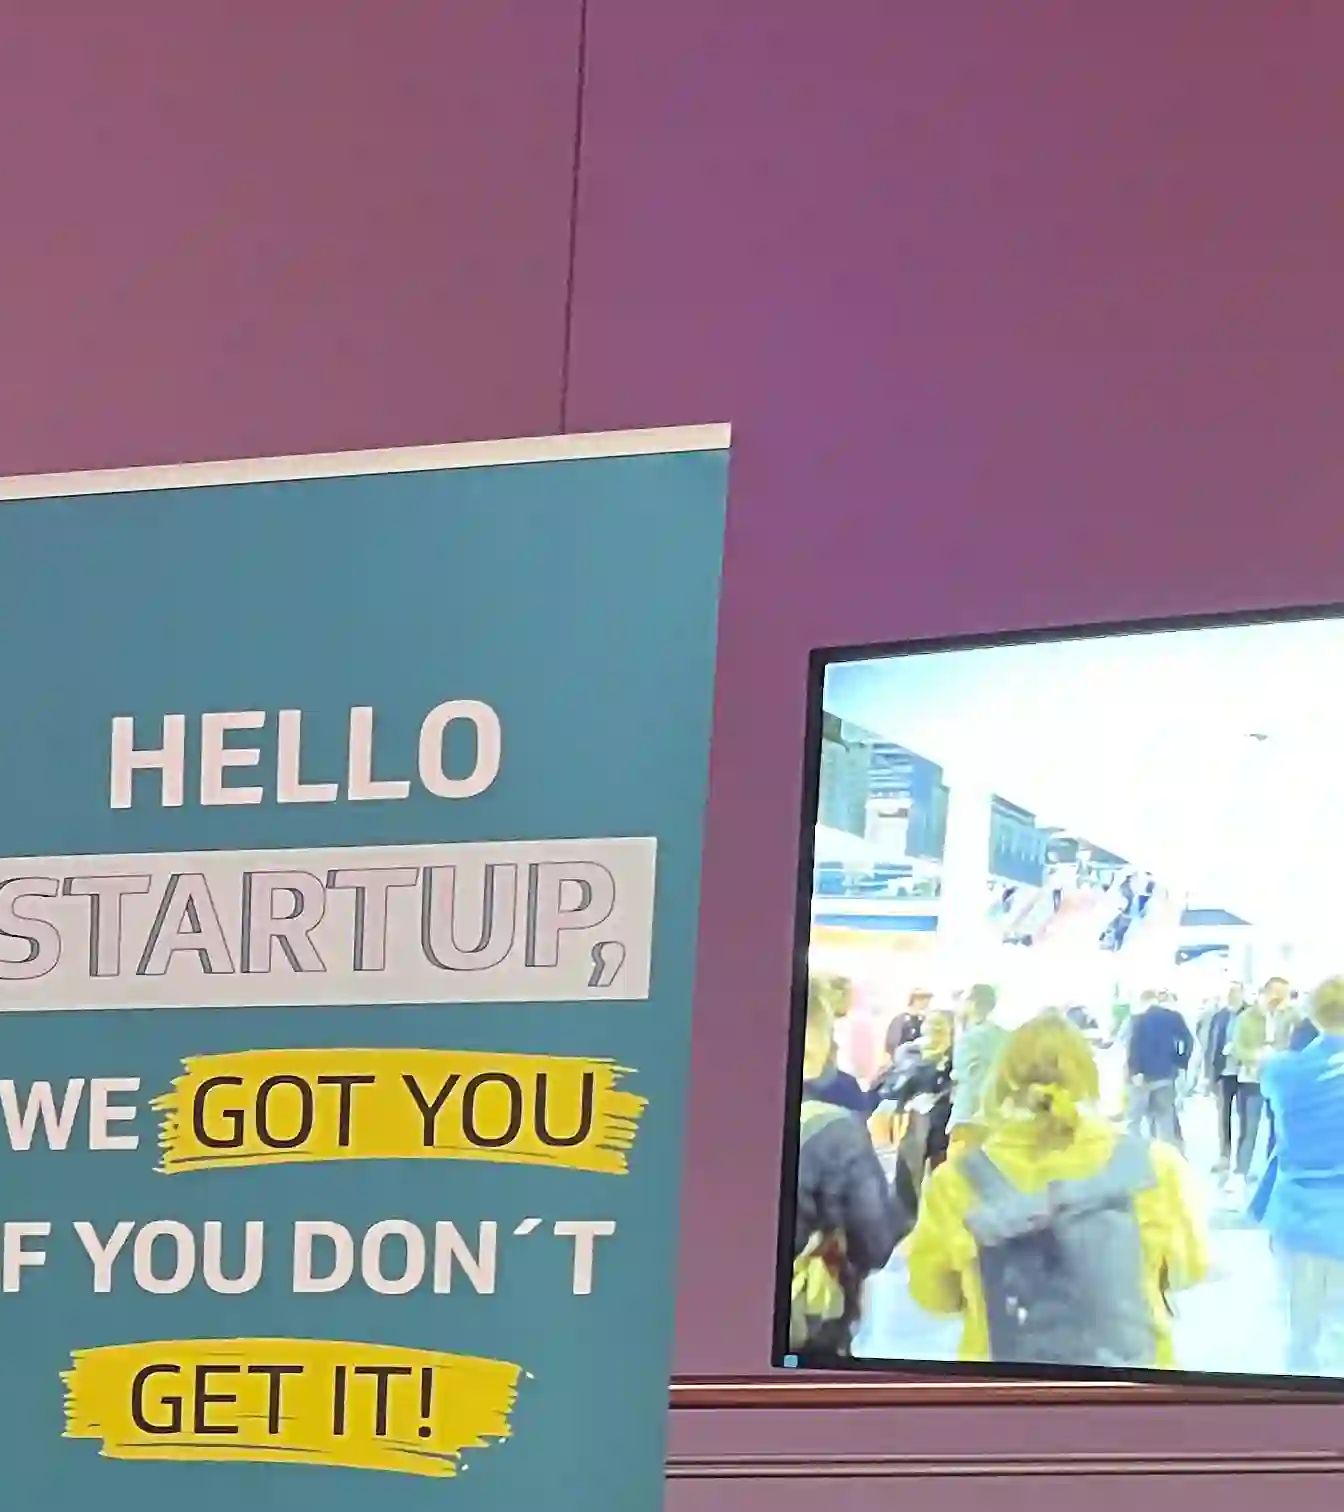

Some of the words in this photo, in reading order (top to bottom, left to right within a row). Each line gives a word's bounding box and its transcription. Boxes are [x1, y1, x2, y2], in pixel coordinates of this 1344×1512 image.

[108, 699, 502, 809] HELLO
[191, 1074, 376, 1149] GOT
[402, 1071, 596, 1149] YOU
[73, 1219, 270, 1295] YOU
[130, 1363, 305, 1436] GET
[333, 1364, 434, 1438] IT!
